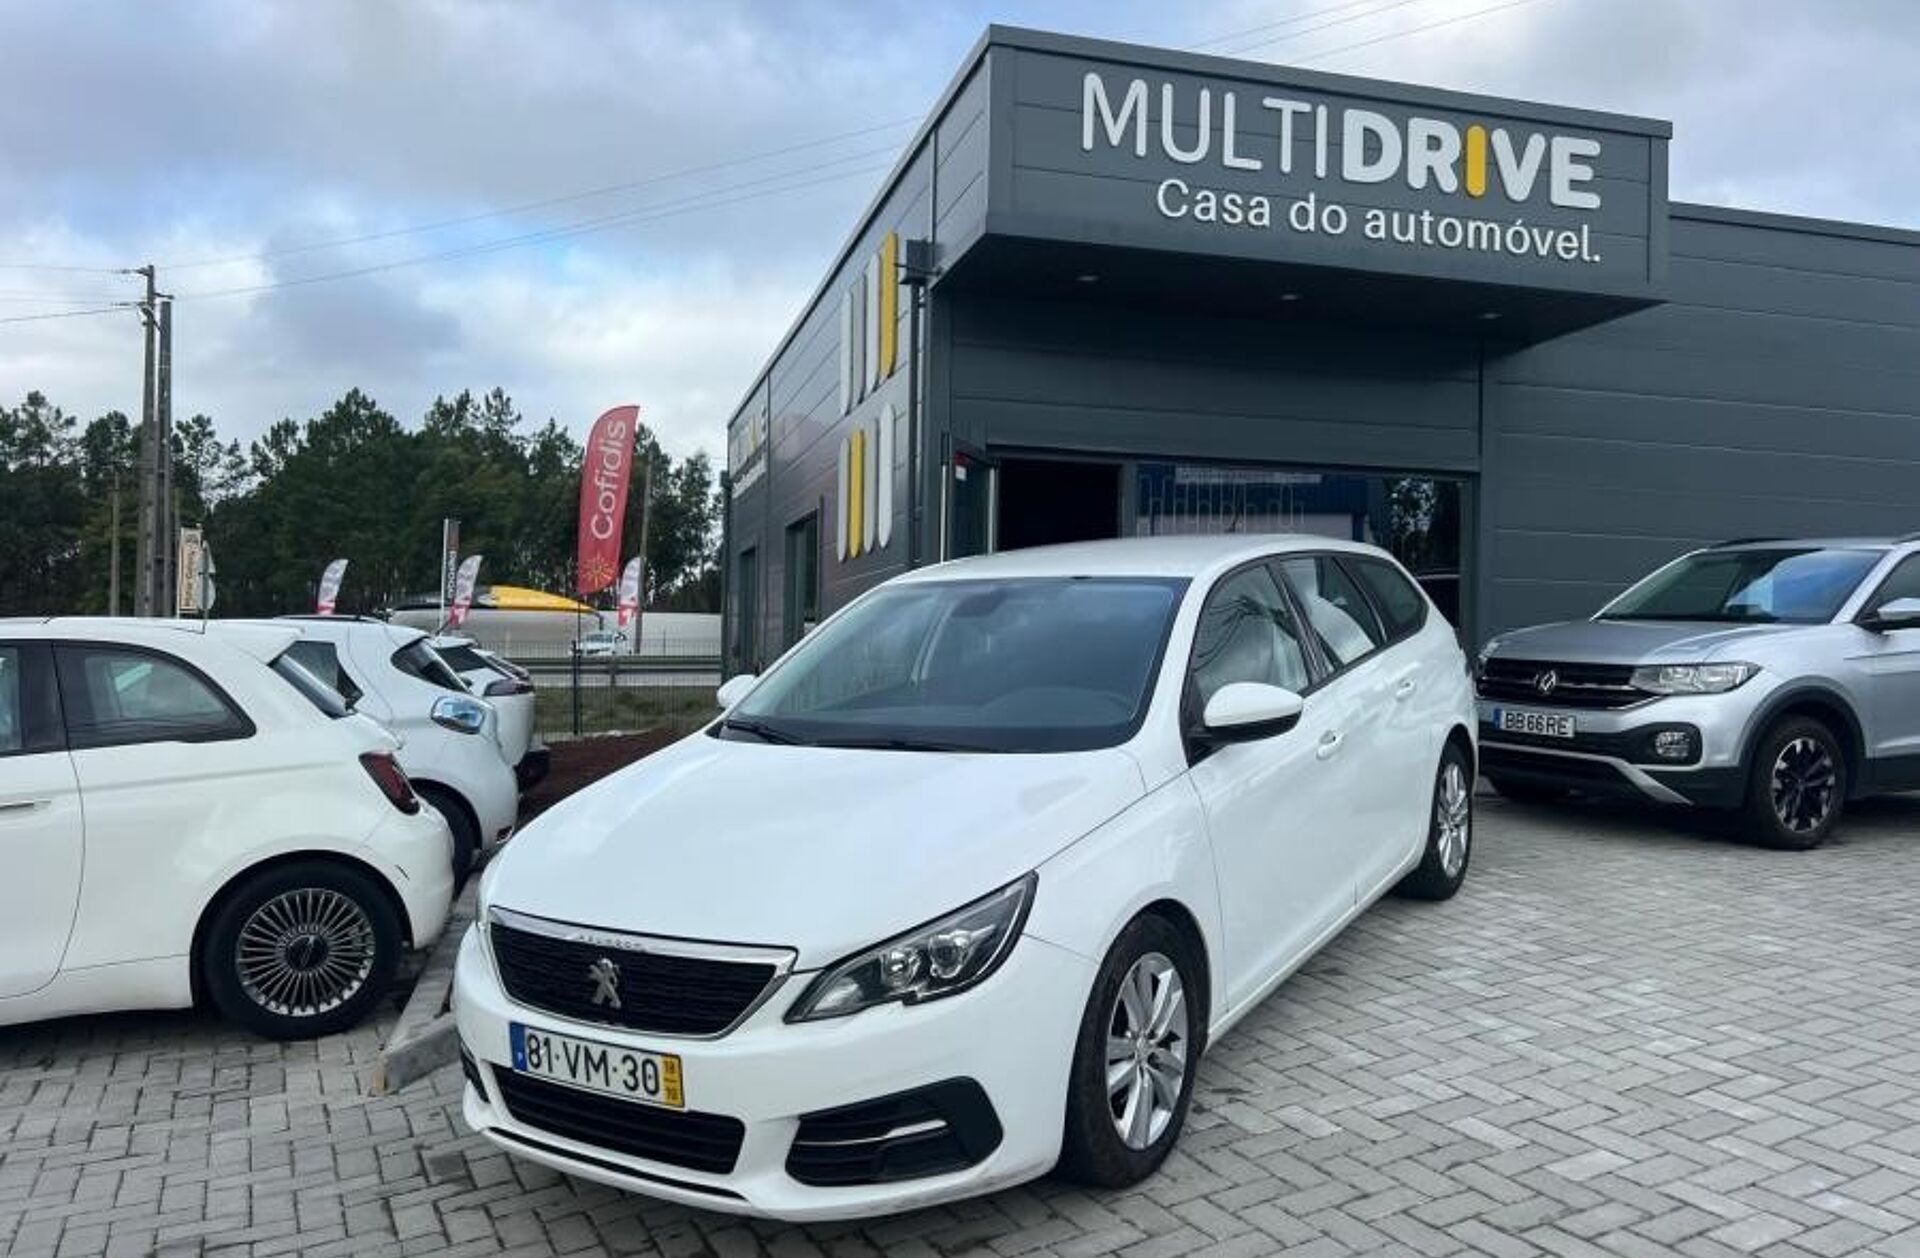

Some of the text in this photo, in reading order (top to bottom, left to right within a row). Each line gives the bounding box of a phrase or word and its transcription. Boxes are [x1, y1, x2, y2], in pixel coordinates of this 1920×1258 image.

[1083, 72, 1601, 209] MULTIDRIVE
[1157, 178, 1601, 262] Casa do automóvel.
[591, 420, 627, 539] Cofidis
